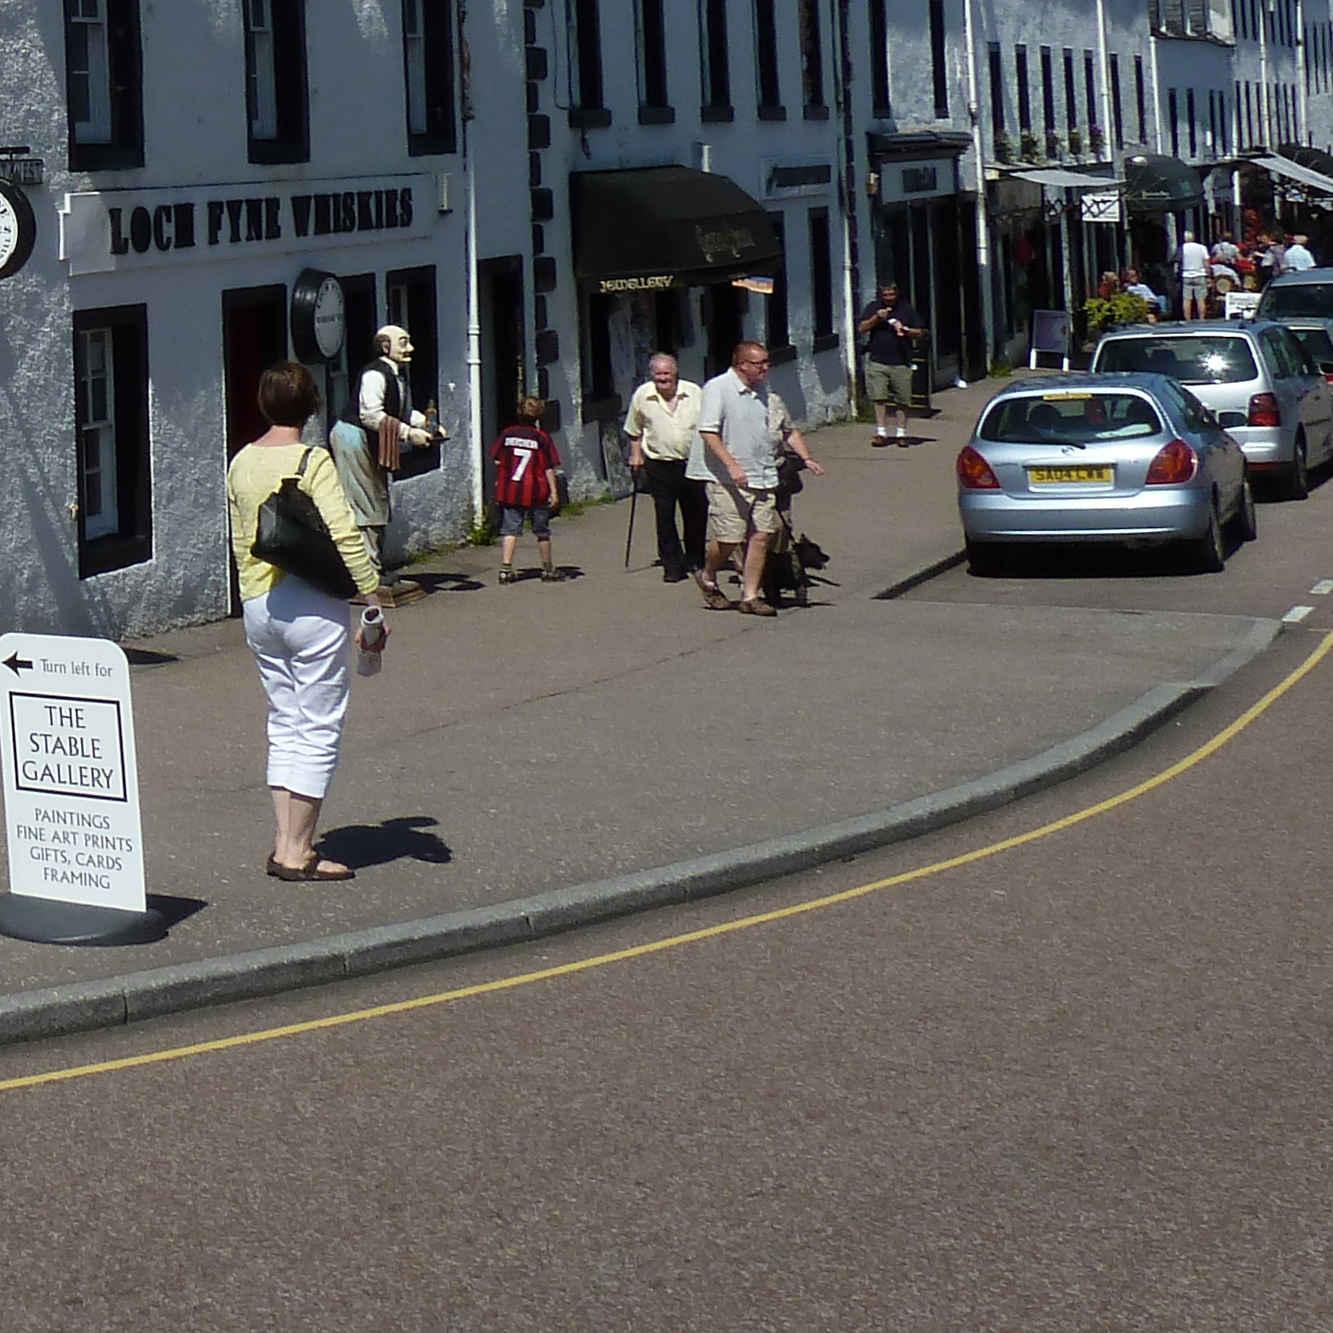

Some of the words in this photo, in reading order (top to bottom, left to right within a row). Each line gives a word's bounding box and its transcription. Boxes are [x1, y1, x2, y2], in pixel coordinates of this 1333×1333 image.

[109, 203, 196, 254] LOCH
[207, 198, 281, 245] FYNE
[291, 188, 414, 237] WHISKIES
[512, 447, 532, 481] 7
[40, 658, 67, 674] Turn
[71, 661, 90, 676] left
[95, 662, 113, 678] for
[44, 705, 86, 729] THE
[29, 732, 102, 759] STABLE
[22, 760, 113, 789] GALLERY
[34, 807, 110, 830] PAINTINGS
[16, 824, 46, 841] FINE
[51, 830, 79, 845] ART
[84, 833, 133, 852] PRINTS
[30, 846, 71, 865] GIFTS,
[75, 852, 123, 871] CARDS
[43, 866, 111, 889] FRAMING
